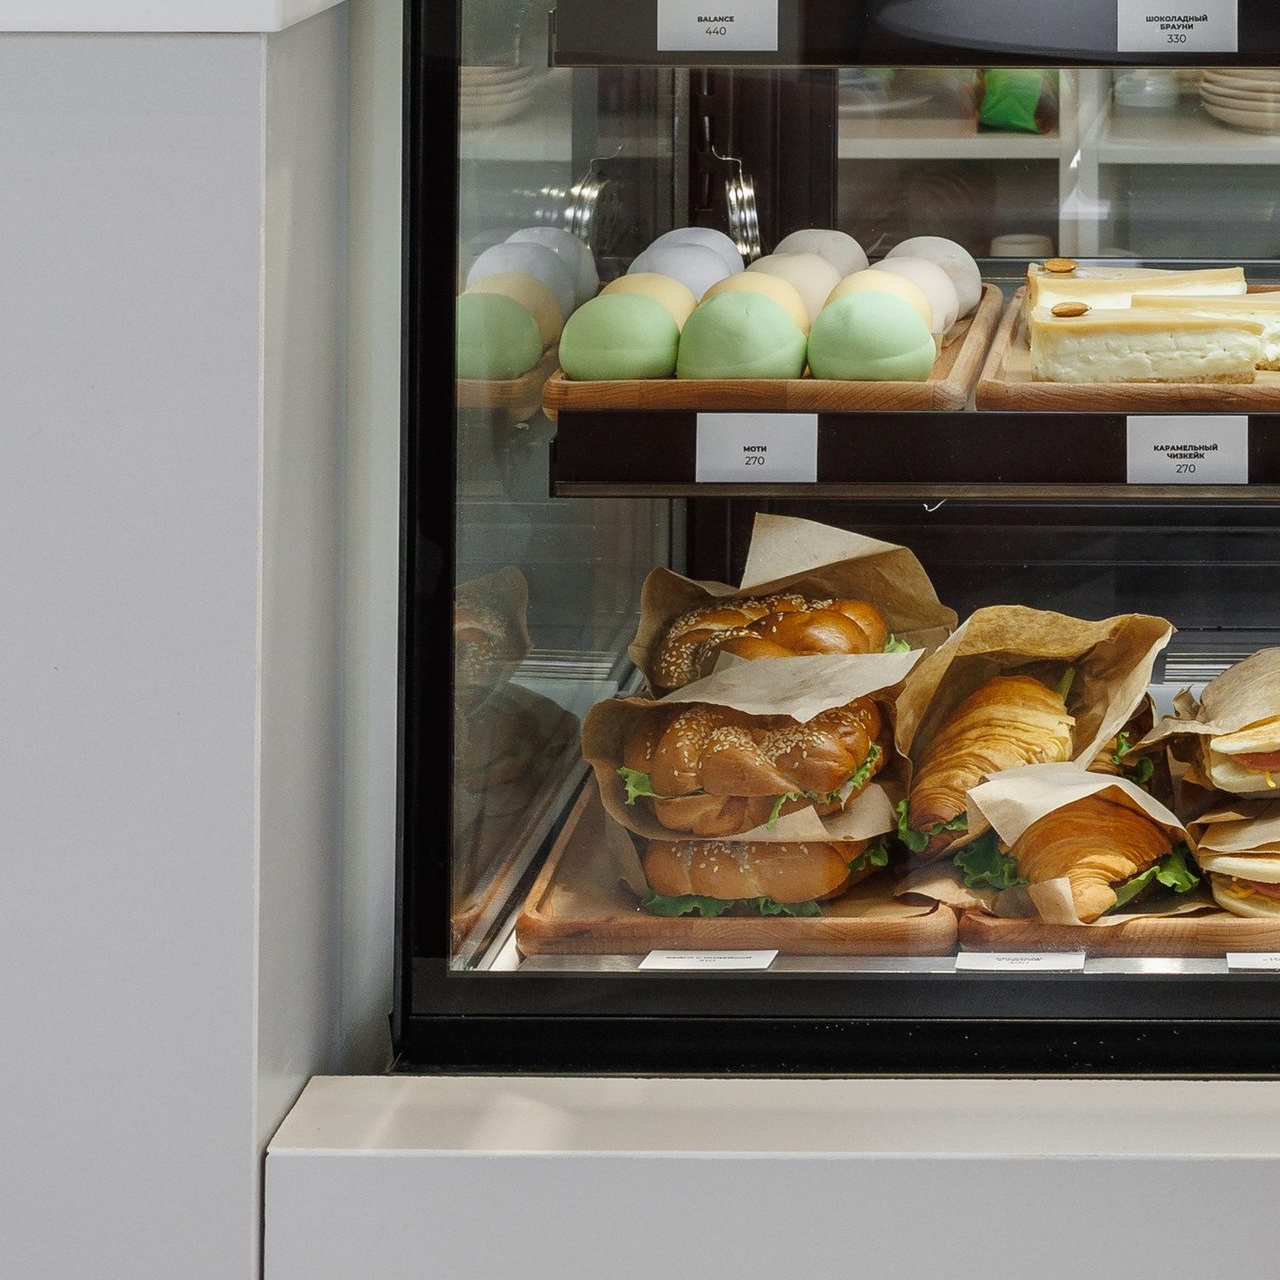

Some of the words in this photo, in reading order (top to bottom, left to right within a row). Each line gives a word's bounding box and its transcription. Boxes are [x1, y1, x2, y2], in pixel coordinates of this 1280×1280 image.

[697, 15, 735, 23] BALANCE
[1145, 13, 1209, 23] ШОКОЛАДНЫЙ
[704, 26, 727, 36] 440
[1160, 23, 1194, 31] БРАУНИ
[1166, 33, 1187, 44] 330
[743, 445, 767, 453] МОТИ
[1153, 442, 1219, 452] КАРАМЕЛЬНЫЙ
[744, 455, 766, 466] 270
[1166, 451, 1205, 460] ЧИЗКЕЙК
[1175, 463, 1197, 474] 270
